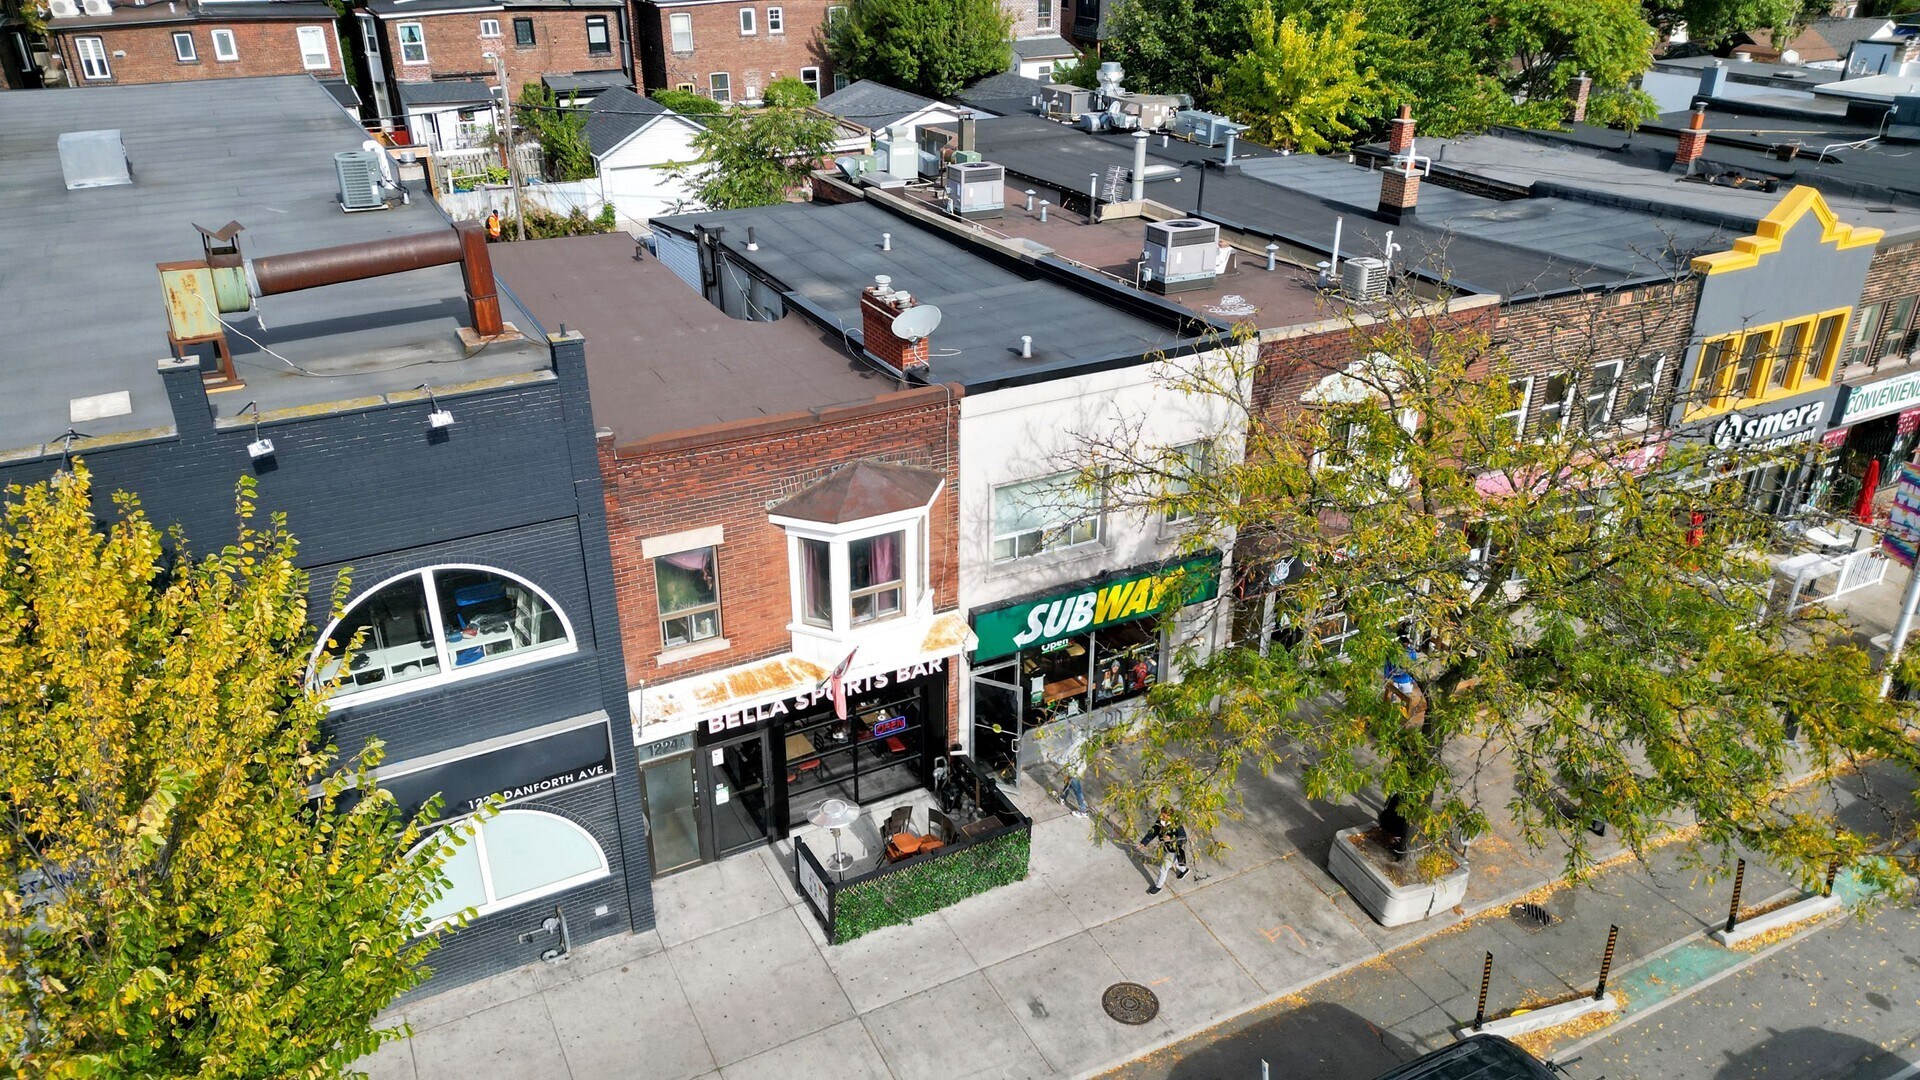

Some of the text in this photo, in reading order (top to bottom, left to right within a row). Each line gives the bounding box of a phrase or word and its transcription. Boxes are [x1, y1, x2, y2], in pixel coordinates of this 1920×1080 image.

[707, 700, 789, 734] BELLA
[896, 658, 943, 684] BAR
[876, 719, 904, 734] OPEN
[468, 764, 608, 809] 122 DANFORTH AVE.
